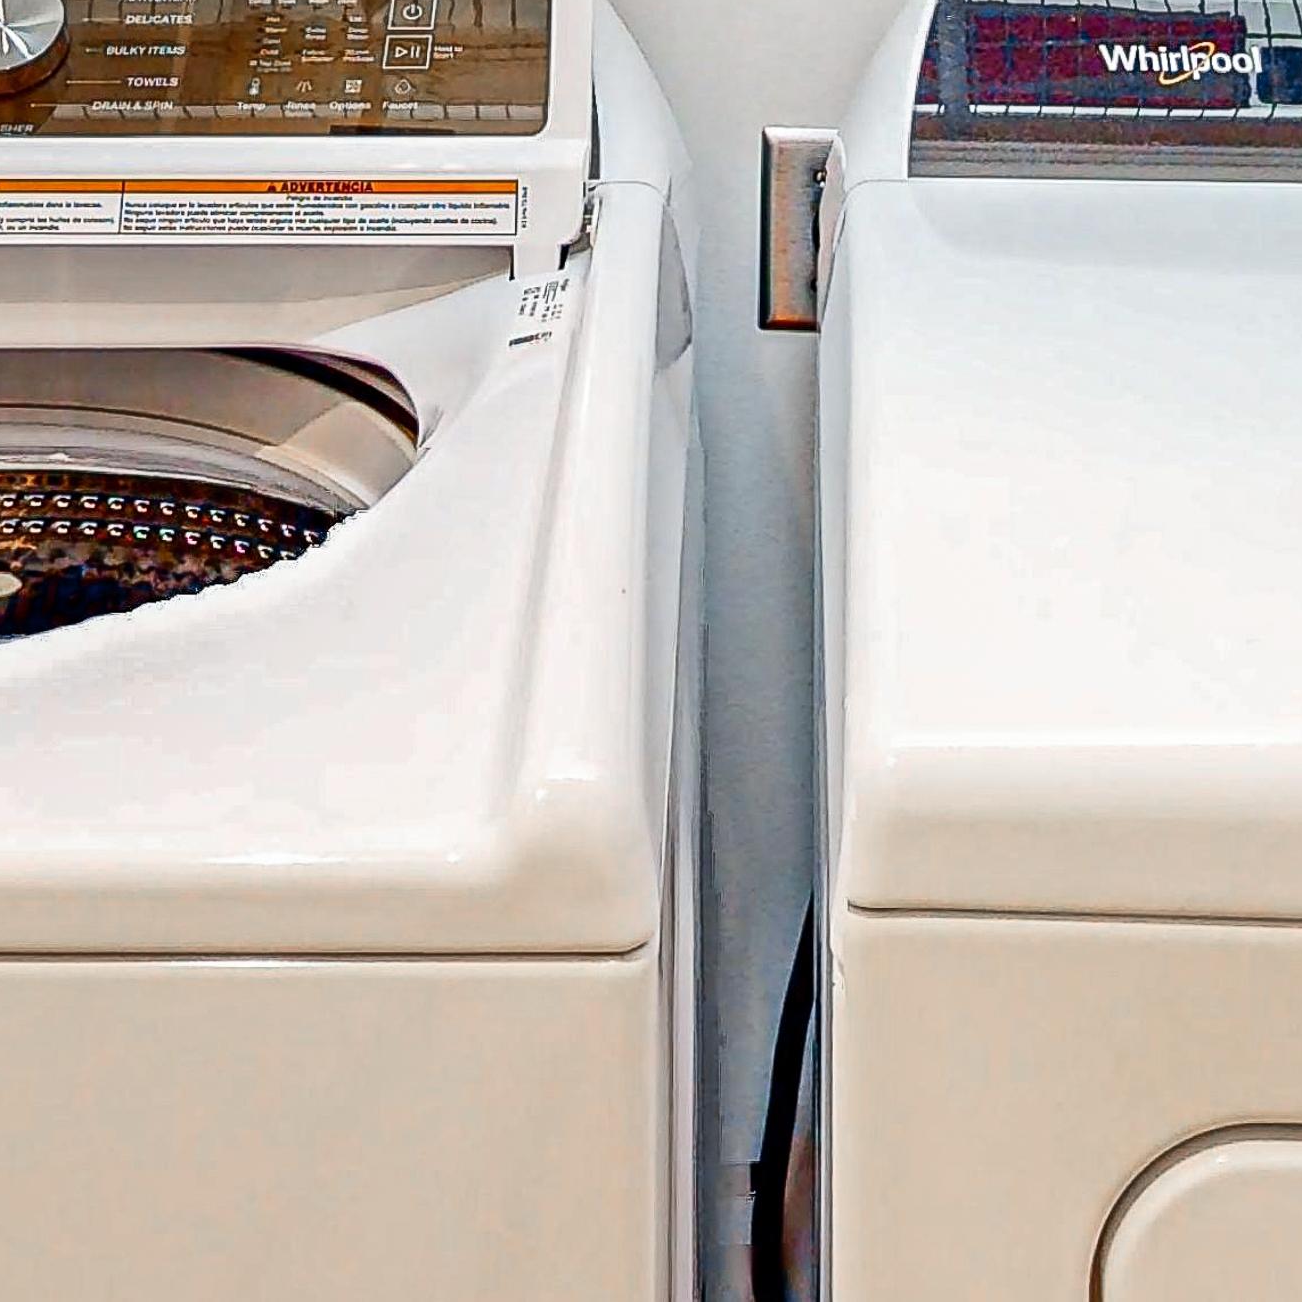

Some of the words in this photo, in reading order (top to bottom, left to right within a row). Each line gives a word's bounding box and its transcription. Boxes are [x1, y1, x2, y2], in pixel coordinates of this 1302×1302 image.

[125, 14, 193, 24] DELICATES
[106, 45, 146, 55] BULKY
[147, 45, 186, 55] ITEMS
[1098, 43, 1263, 83] Whirlpool
[126, 76, 178, 86] TOWELS
[92, 101, 131, 111] DRAIN
[144, 101, 174, 111] SPIN
[280, 181, 374, 192] ADVERTENCIA
